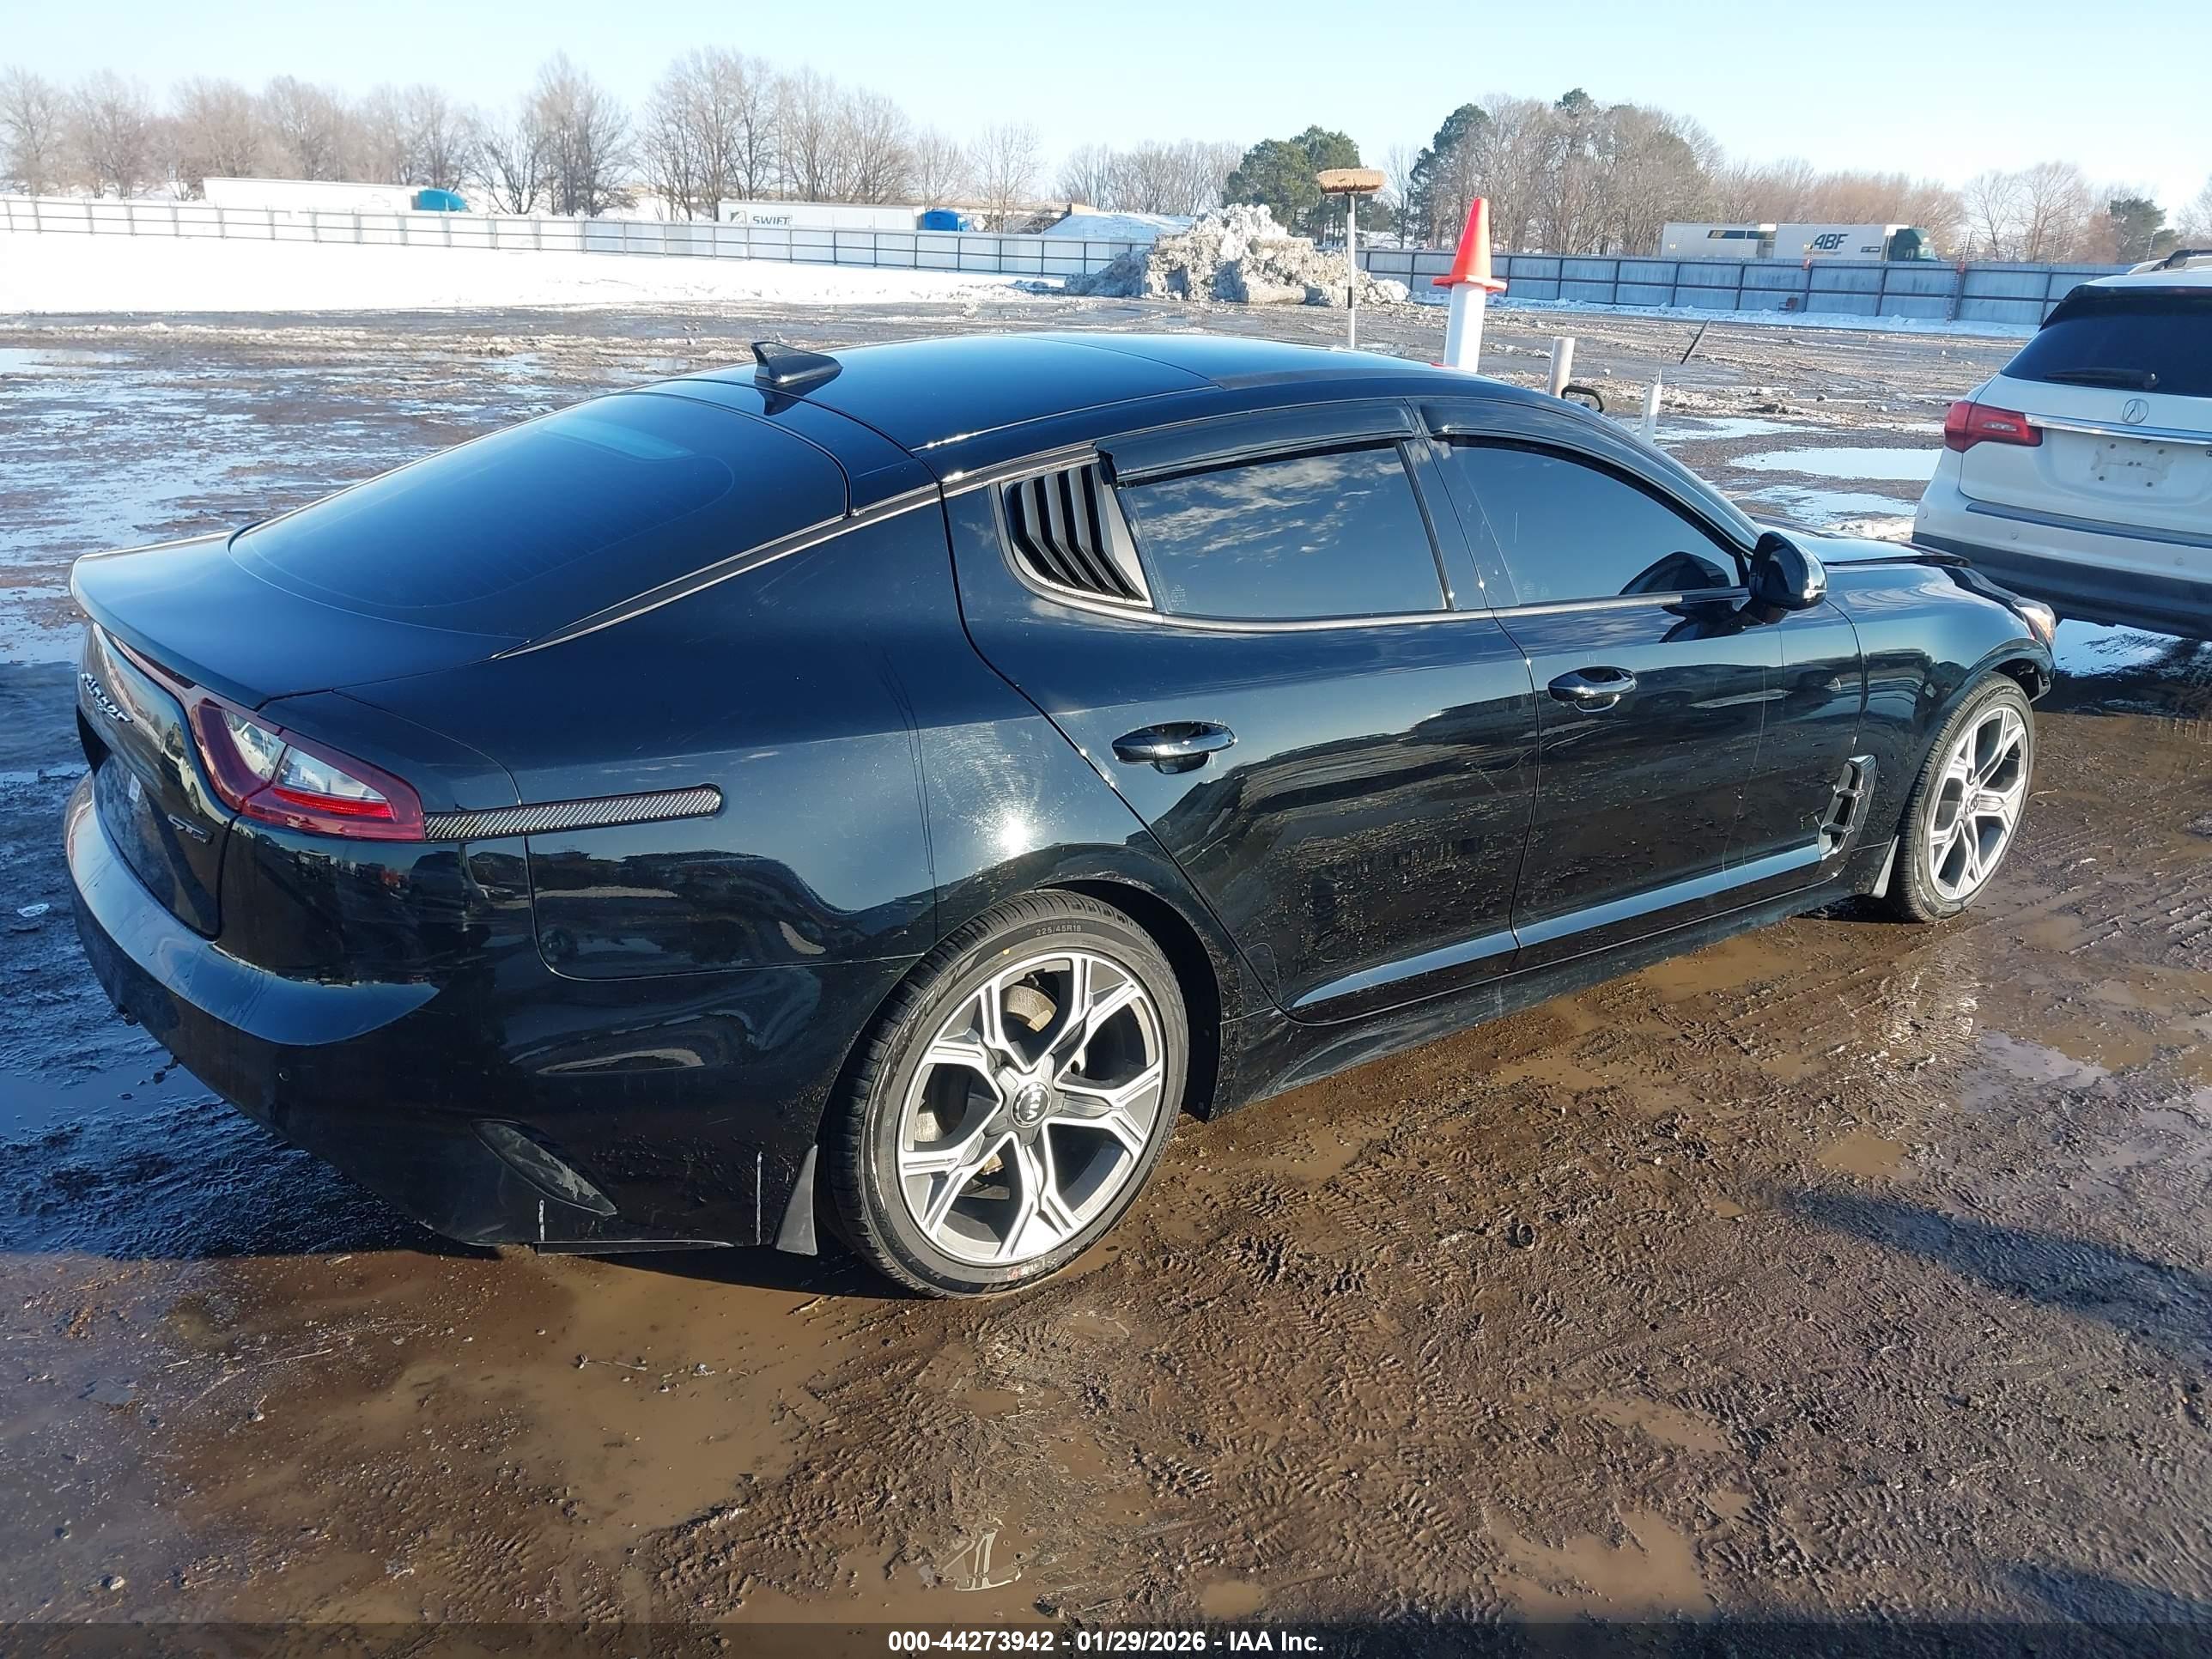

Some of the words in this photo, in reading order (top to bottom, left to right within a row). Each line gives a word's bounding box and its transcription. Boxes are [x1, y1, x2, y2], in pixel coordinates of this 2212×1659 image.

[752, 216, 791, 225] SWIFT
[1810, 234, 1850, 250] ABF
[1036, 925, 1082, 936] 225/45R18
[1026, 1091, 1042, 1120] KIA
